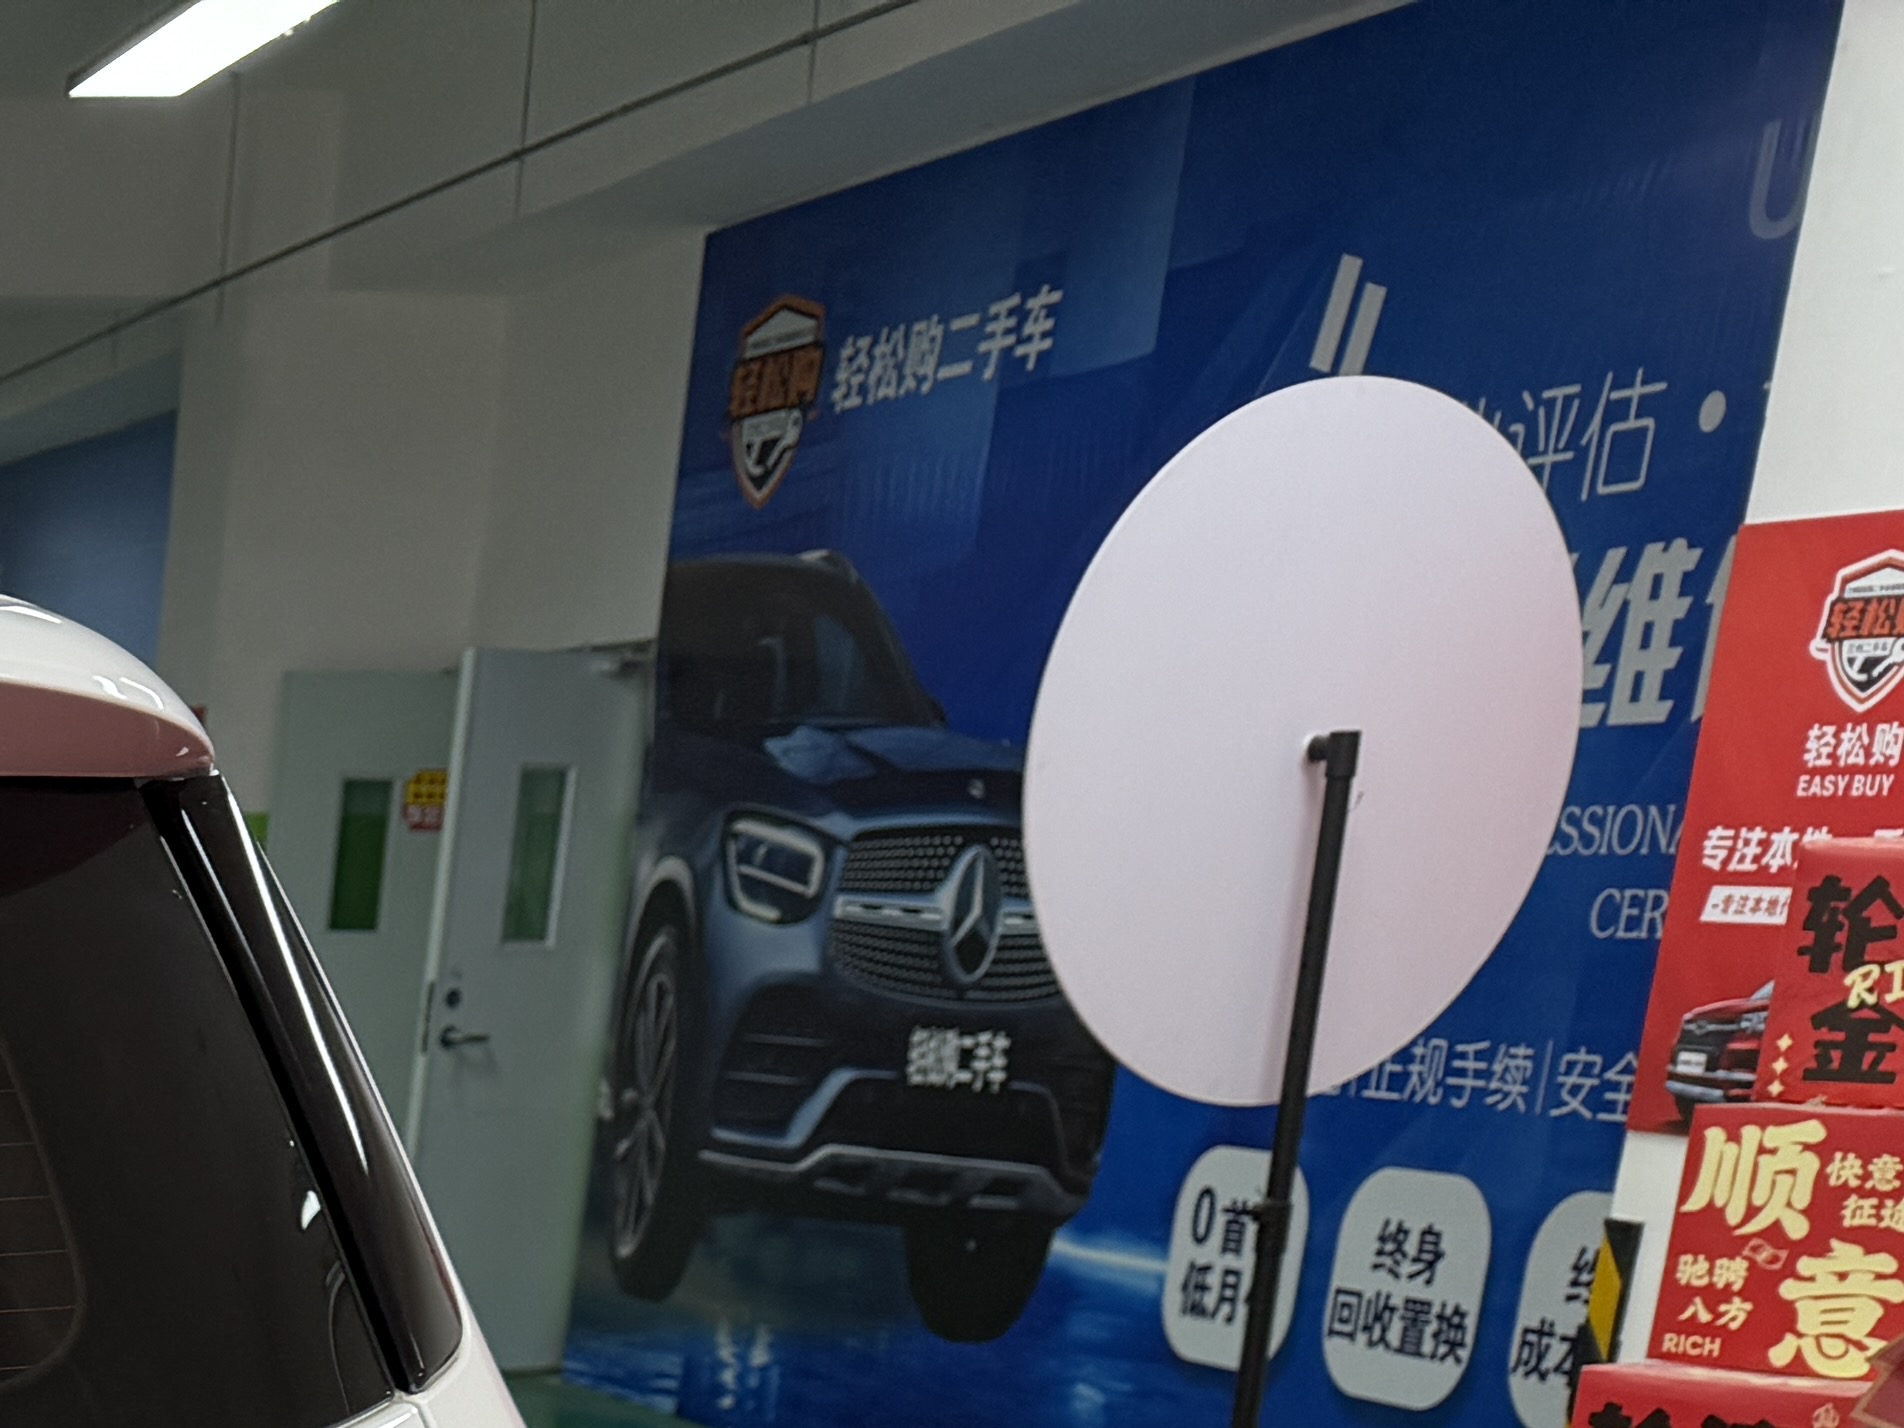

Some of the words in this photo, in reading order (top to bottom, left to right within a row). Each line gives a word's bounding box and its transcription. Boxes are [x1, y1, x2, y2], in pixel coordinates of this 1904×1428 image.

[831, 285, 1064, 413] 轻松购二手车
[1826, 600, 1904, 641] 轻松
[1802, 721, 1904, 769] 轻松购
[1796, 774, 1848, 798] EASY
[1851, 774, 1895, 798] BUY
[1549, 803, 1684, 856] SSION
[1678, 1118, 1828, 1241] 顺
[1825, 1151, 1904, 1192] 快意
[1371, 1216, 1445, 1288] 终身
[1325, 1285, 1469, 1367] 回收置换
[1677, 1295, 1754, 1331] 八方
[1768, 1237, 1904, 1380] 意
[1661, 1332, 1722, 1358] RICH
